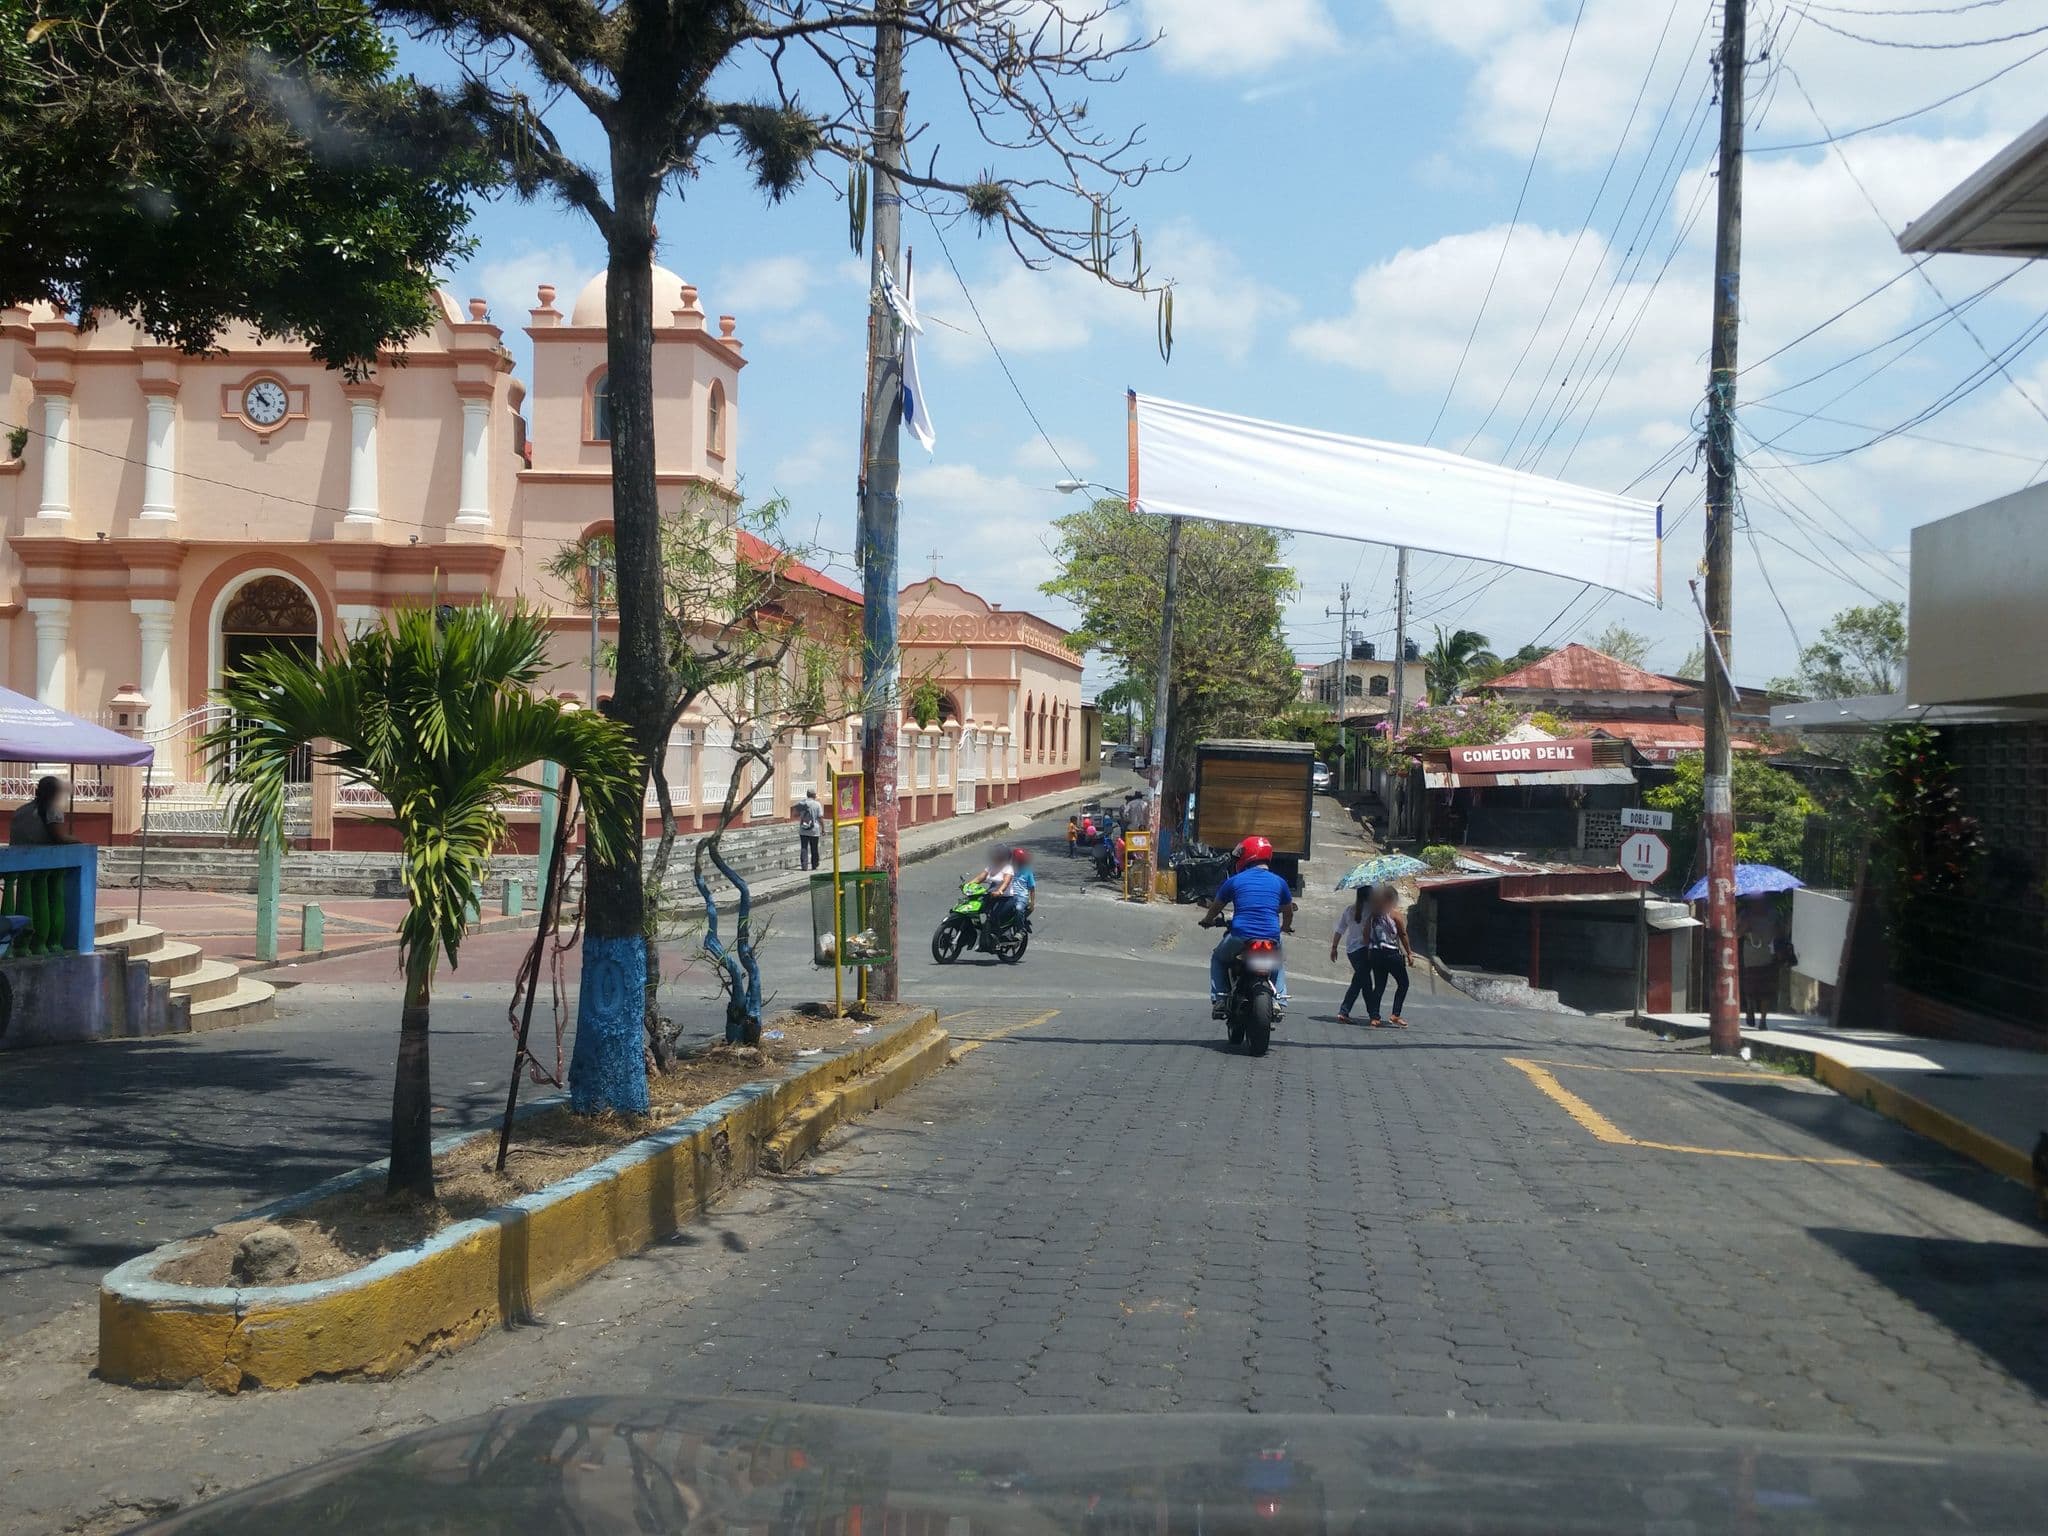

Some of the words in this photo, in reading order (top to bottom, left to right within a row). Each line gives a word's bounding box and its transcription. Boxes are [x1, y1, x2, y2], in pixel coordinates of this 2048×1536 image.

[1462, 748, 1531, 762] COMEDOR
[1536, 746, 1575, 760] DEMI
[1630, 812, 1649, 826] DOBLE
[1652, 814, 1663, 827] VIA
